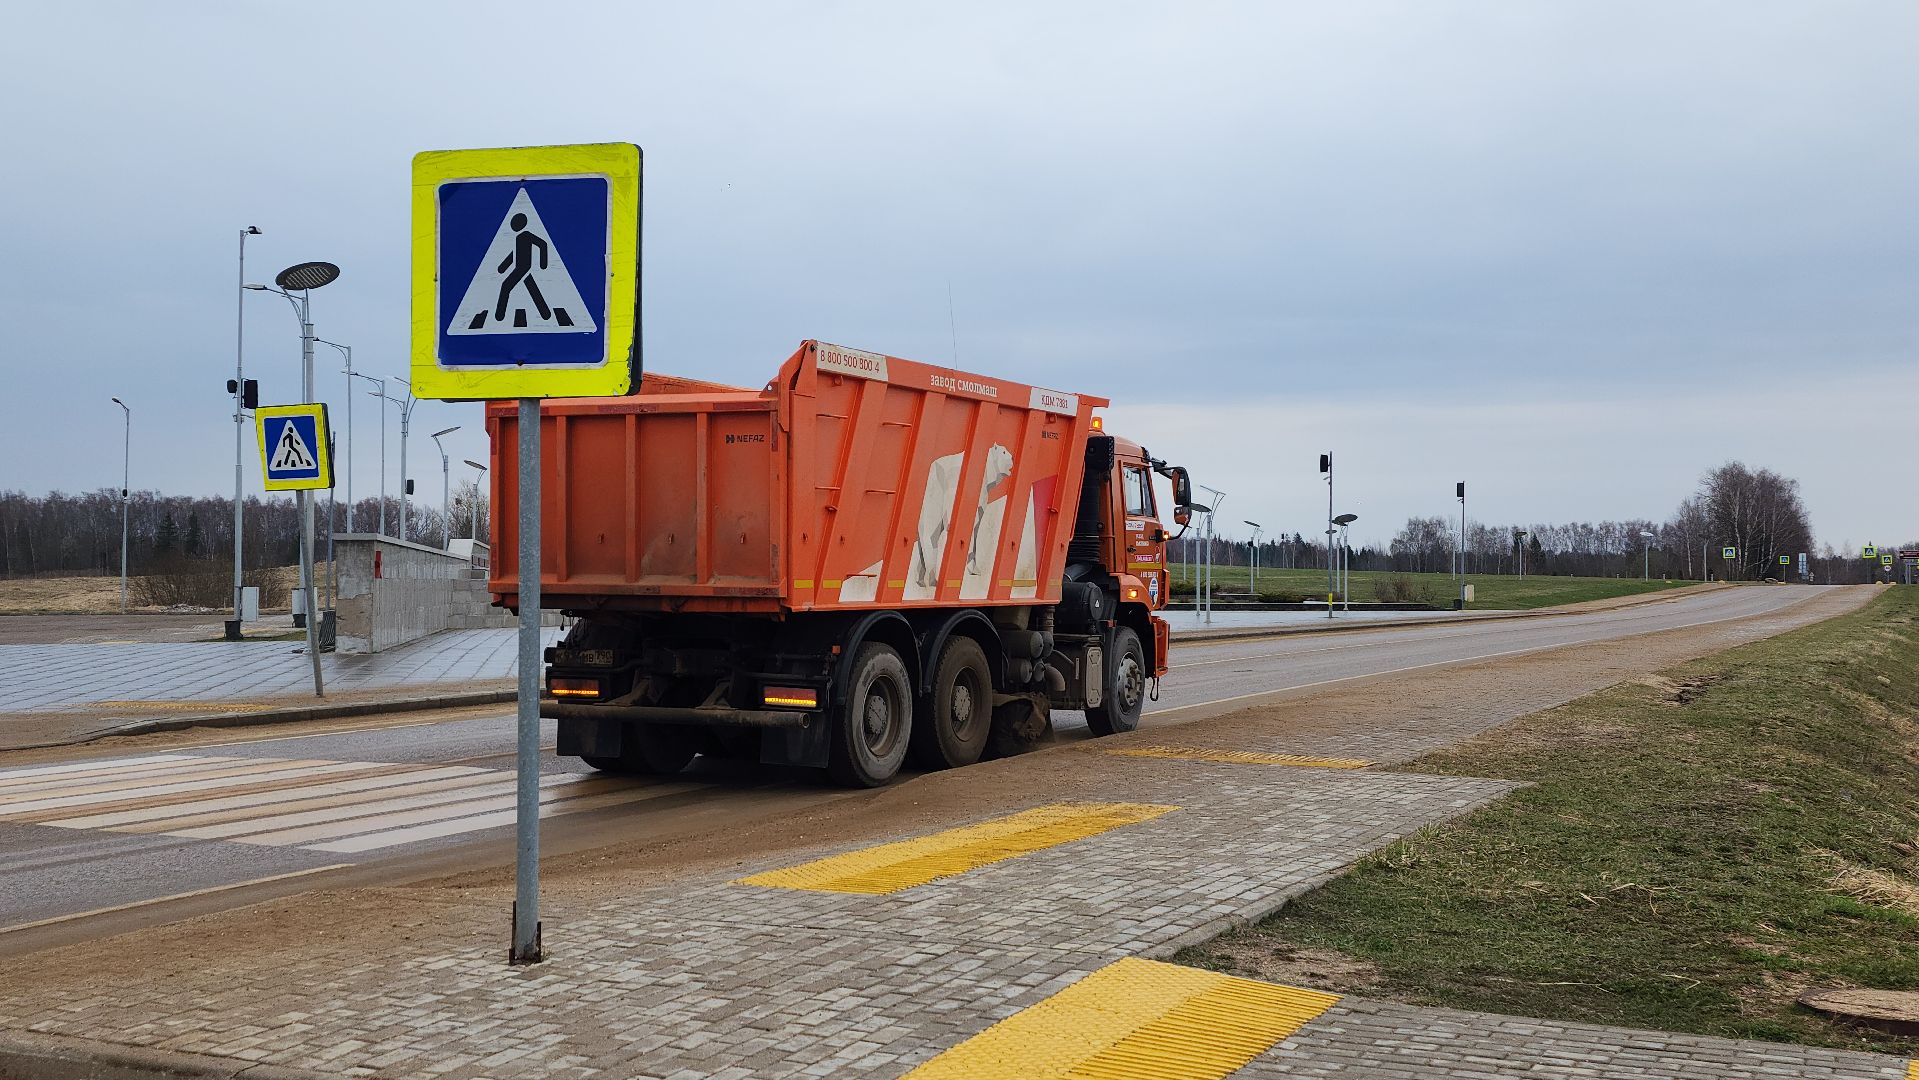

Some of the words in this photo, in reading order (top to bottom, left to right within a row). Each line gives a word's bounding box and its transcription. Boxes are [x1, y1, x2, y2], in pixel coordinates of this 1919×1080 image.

[820, 350, 826, 362] 8
[827, 351, 842, 365] 800
[843, 354, 858, 368] 500
[874, 361, 880, 374] 4
[736, 434, 765, 443] NEFAZ
